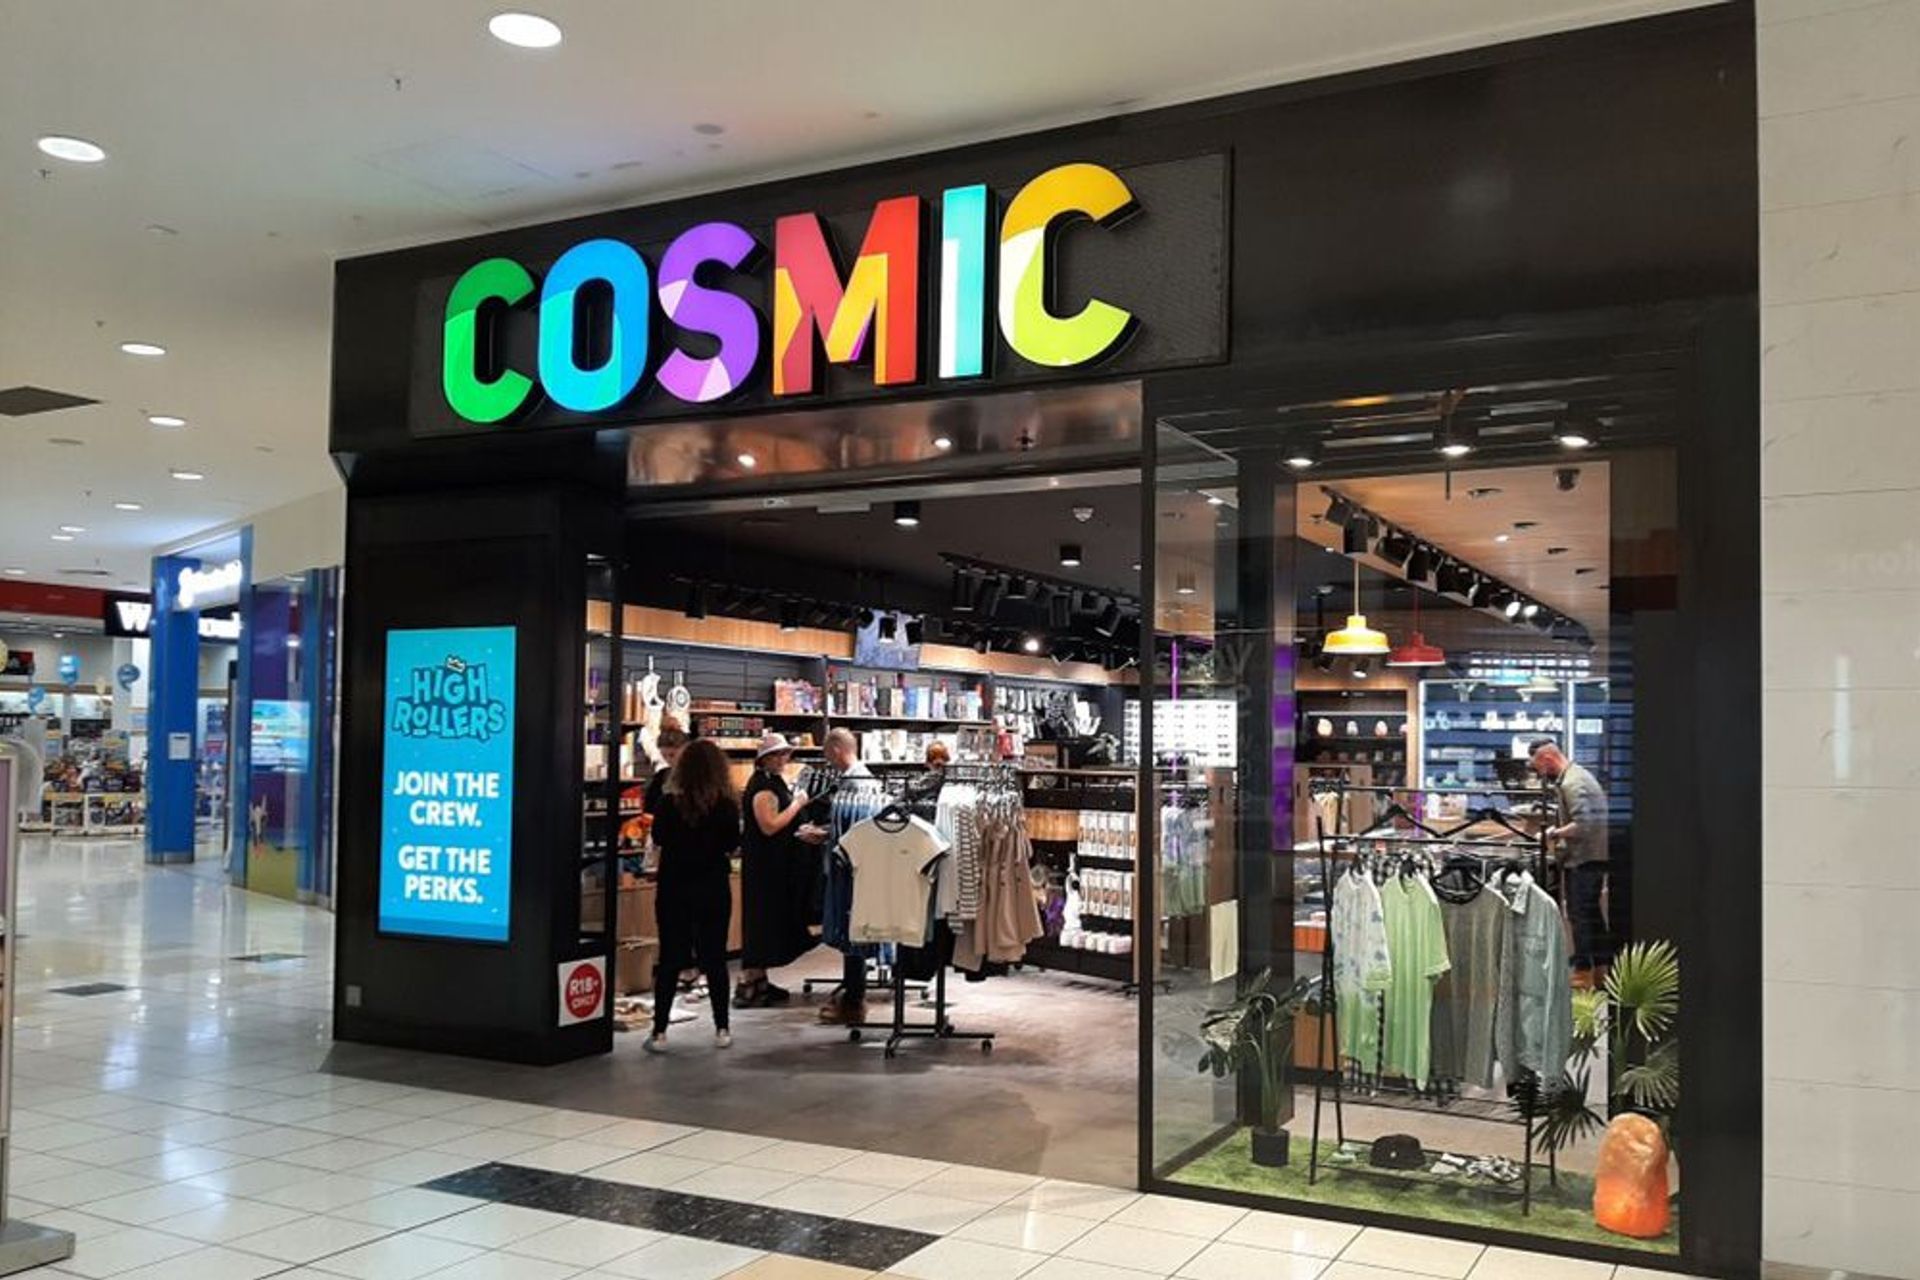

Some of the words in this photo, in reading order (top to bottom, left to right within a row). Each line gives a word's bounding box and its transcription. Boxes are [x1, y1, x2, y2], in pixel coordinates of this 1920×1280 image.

[443, 163, 1133, 424] COSMIC
[412, 665, 488, 705] HIGH
[393, 700, 504, 740] ROLLERS
[393, 771, 449, 796] JOIN
[453, 772, 500, 798] THE
[409, 799, 483, 827] CREW.
[398, 844, 442, 871] GET
[445, 847, 492, 874] THE
[404, 874, 484, 904] PERKS.
